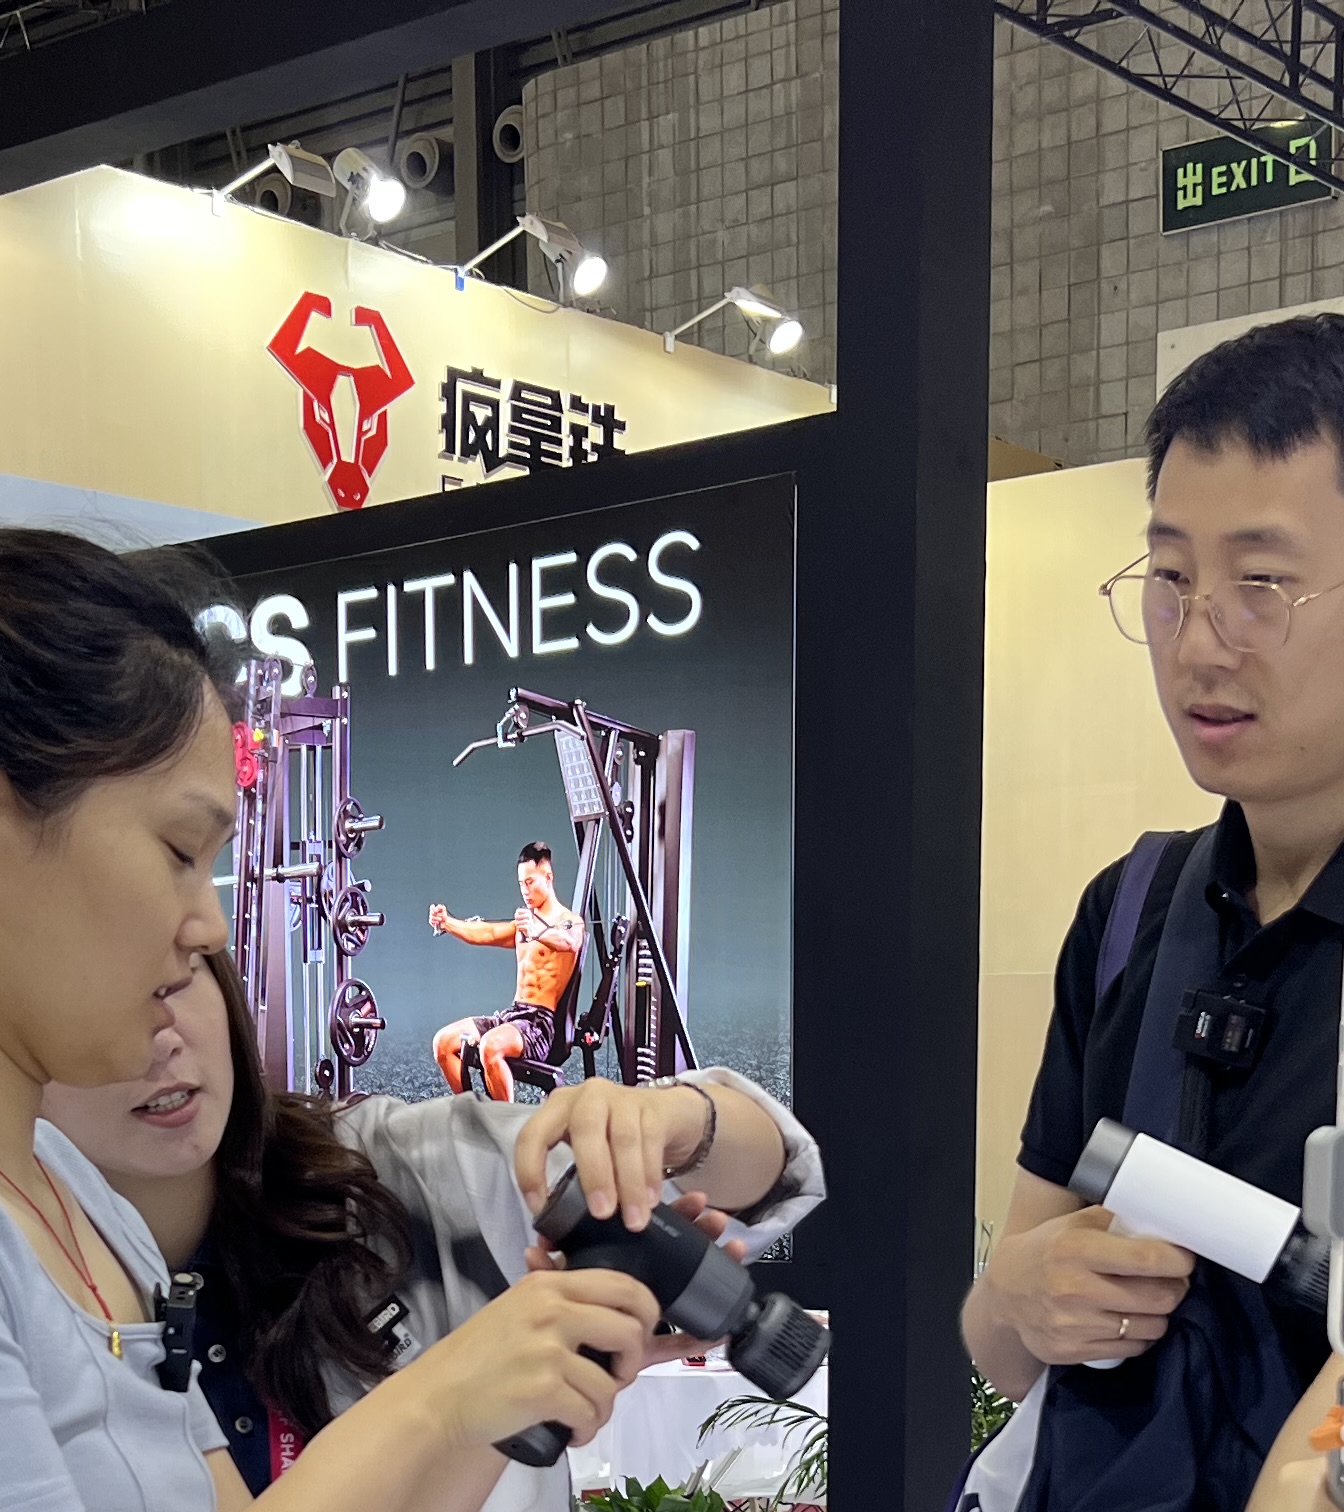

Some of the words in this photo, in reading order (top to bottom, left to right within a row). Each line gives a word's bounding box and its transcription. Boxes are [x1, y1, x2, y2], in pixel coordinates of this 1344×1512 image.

[1177, 162, 1203, 210] 出
[1211, 154, 1276, 196] EXIT
[337, 530, 703, 682] FITNESS
